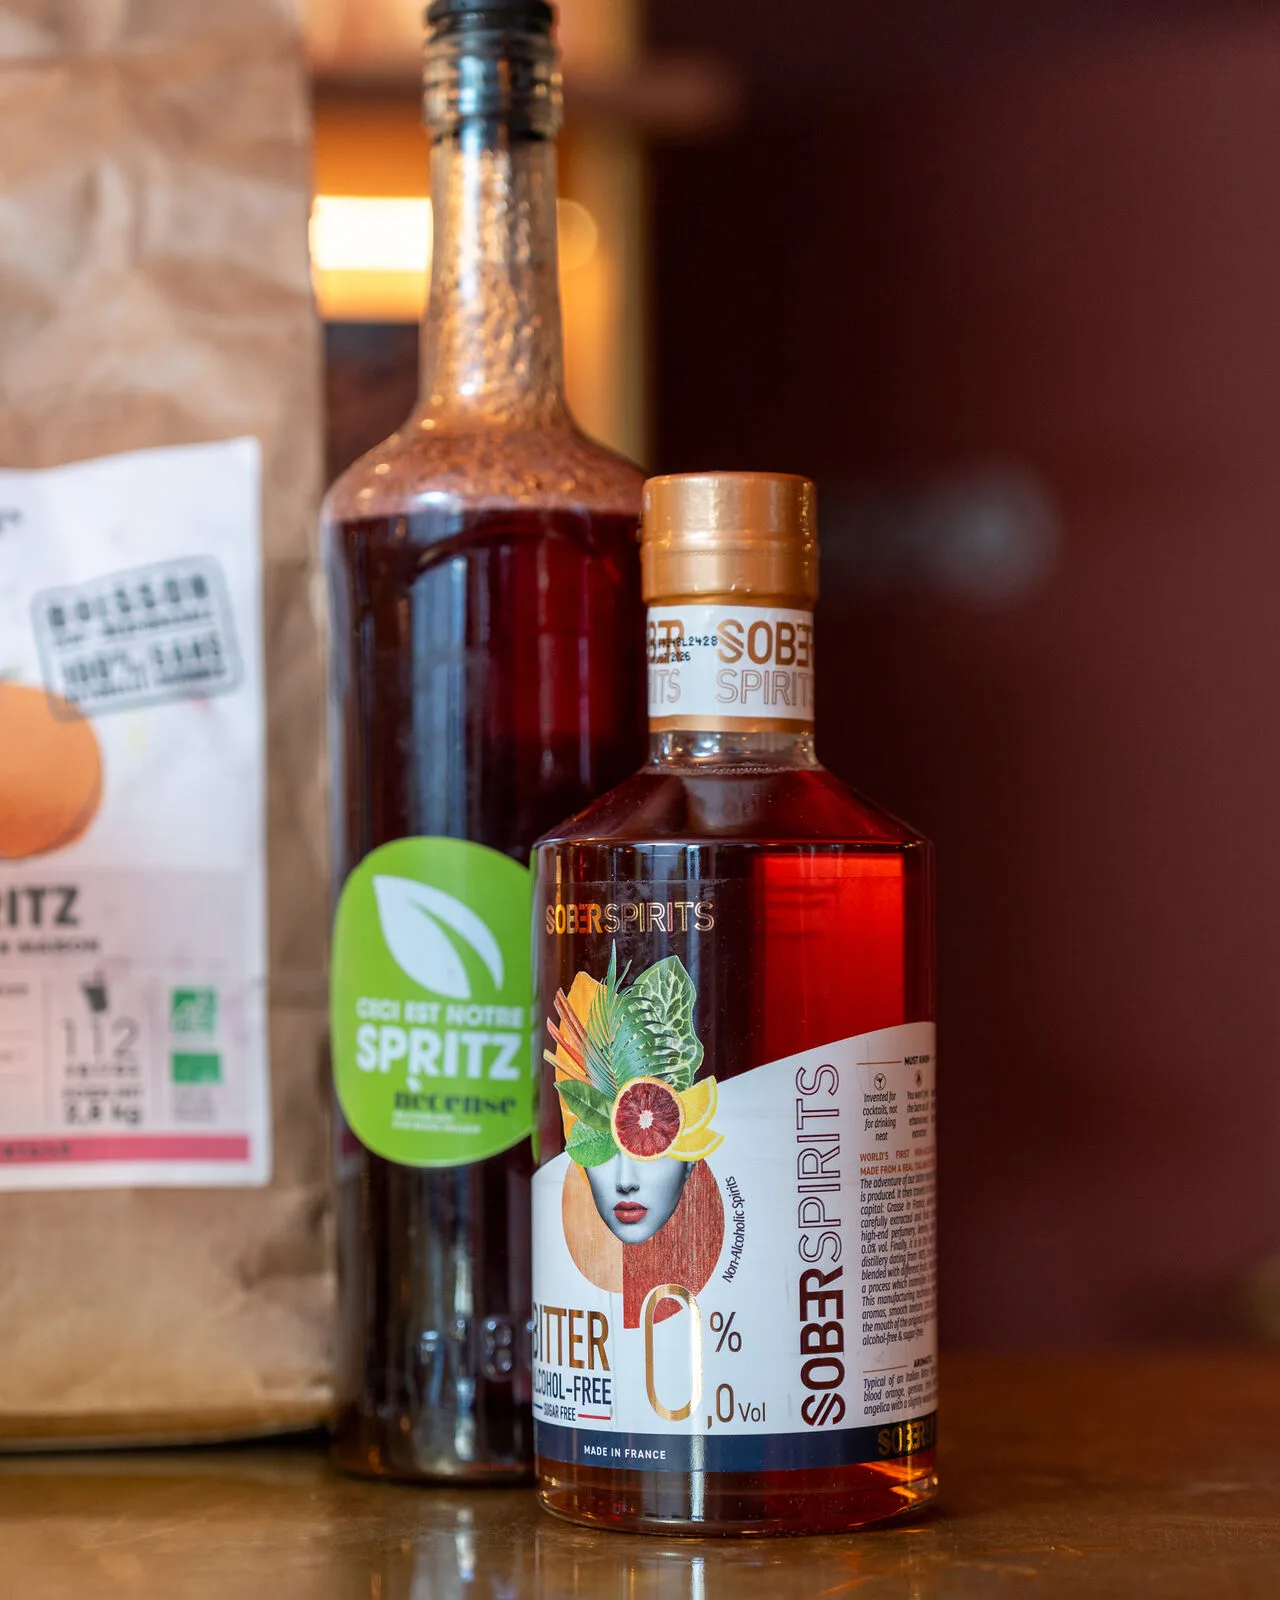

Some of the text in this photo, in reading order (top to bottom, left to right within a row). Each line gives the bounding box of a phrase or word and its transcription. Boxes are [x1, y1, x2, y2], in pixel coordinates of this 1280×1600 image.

[716, 619, 814, 668] SOBE
[0, 885, 79, 927] ITZ
[356, 996, 524, 1029] CECI EST NOTRE
[355, 1023, 522, 1081] SPRITZ
[904, 1056, 918, 1066] MUST
[863, 1091, 897, 1104] Invented for
[862, 1105, 898, 1116] cocktails, not
[864, 1118, 874, 1131] for
[874, 1117, 897, 1129] drinking
[875, 1132, 888, 1141] neat
[860, 1152, 889, 1161] WORLD'S
[896, 1149, 910, 1159] FIRST
[860, 1167, 879, 1176] MADE
[880, 1165, 897, 1175] FROM
[860, 1178, 872, 1189] The
[873, 1177, 901, 1188] adventure
[860, 1191, 866, 1203] is
[887, 1202, 904, 1213] Grasse
[722, 1176, 745, 1283] Non-Alcoholic Spirits
[861, 1216, 888, 1230] carefully
[861, 1229, 888, 1243] high-end
[861, 1244, 876, 1254] 0.0%
[861, 1256, 888, 1268] distillery
[861, 1267, 886, 1281] blended
[887, 1265, 900, 1277] with
[861, 1284, 866, 1293] a
[868, 1282, 891, 1295] process
[862, 1296, 875, 1307] This
[862, 1309, 887, 1320] aromas,
[709, 1311, 742, 1353] %
[862, 1322, 873, 1333] the
[873, 1319, 894, 1331] mouth
[894, 1318, 900, 1330] of
[532, 1302, 611, 1371] BITTER
[862, 1332, 898, 1345] alcohol-free
[534, 1369, 612, 1406] LCOHOL-FREE
[864, 1376, 886, 1390] Typical
[888, 1374, 895, 1387] of
[896, 1375, 904, 1384] an
[864, 1390, 882, 1401] blood
[544, 1402, 576, 1421] SUGAR FREE
[738, 1402, 766, 1422] Vol
[864, 1402, 890, 1416] angelica
[891, 1399, 903, 1411] with
[584, 1445, 666, 1460] MADE IN FRANCE
